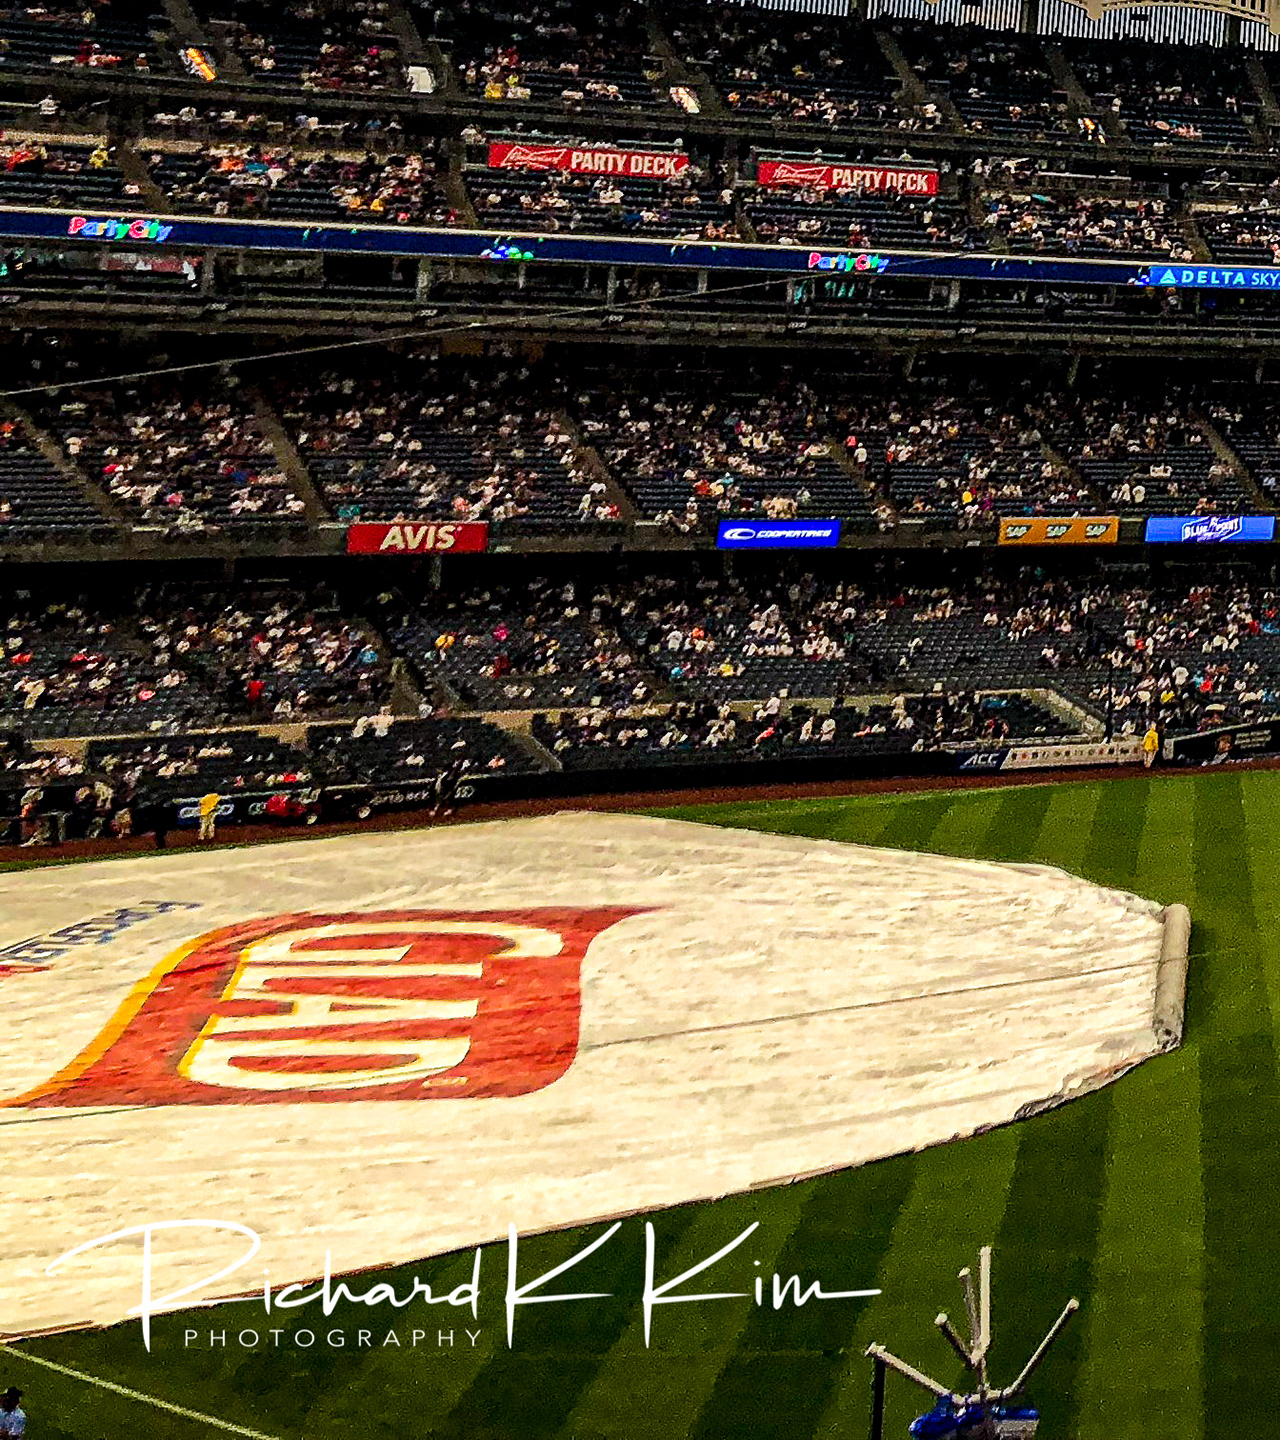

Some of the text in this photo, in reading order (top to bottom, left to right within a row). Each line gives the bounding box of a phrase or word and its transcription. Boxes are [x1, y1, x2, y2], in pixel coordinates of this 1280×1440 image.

[571, 151, 627, 172] PARTY
[631, 155, 676, 175] DECK
[1182, 271, 1246, 285] DELTA
[379, 525, 458, 550] AVIS
[1046, 525, 1068, 538] SAP
